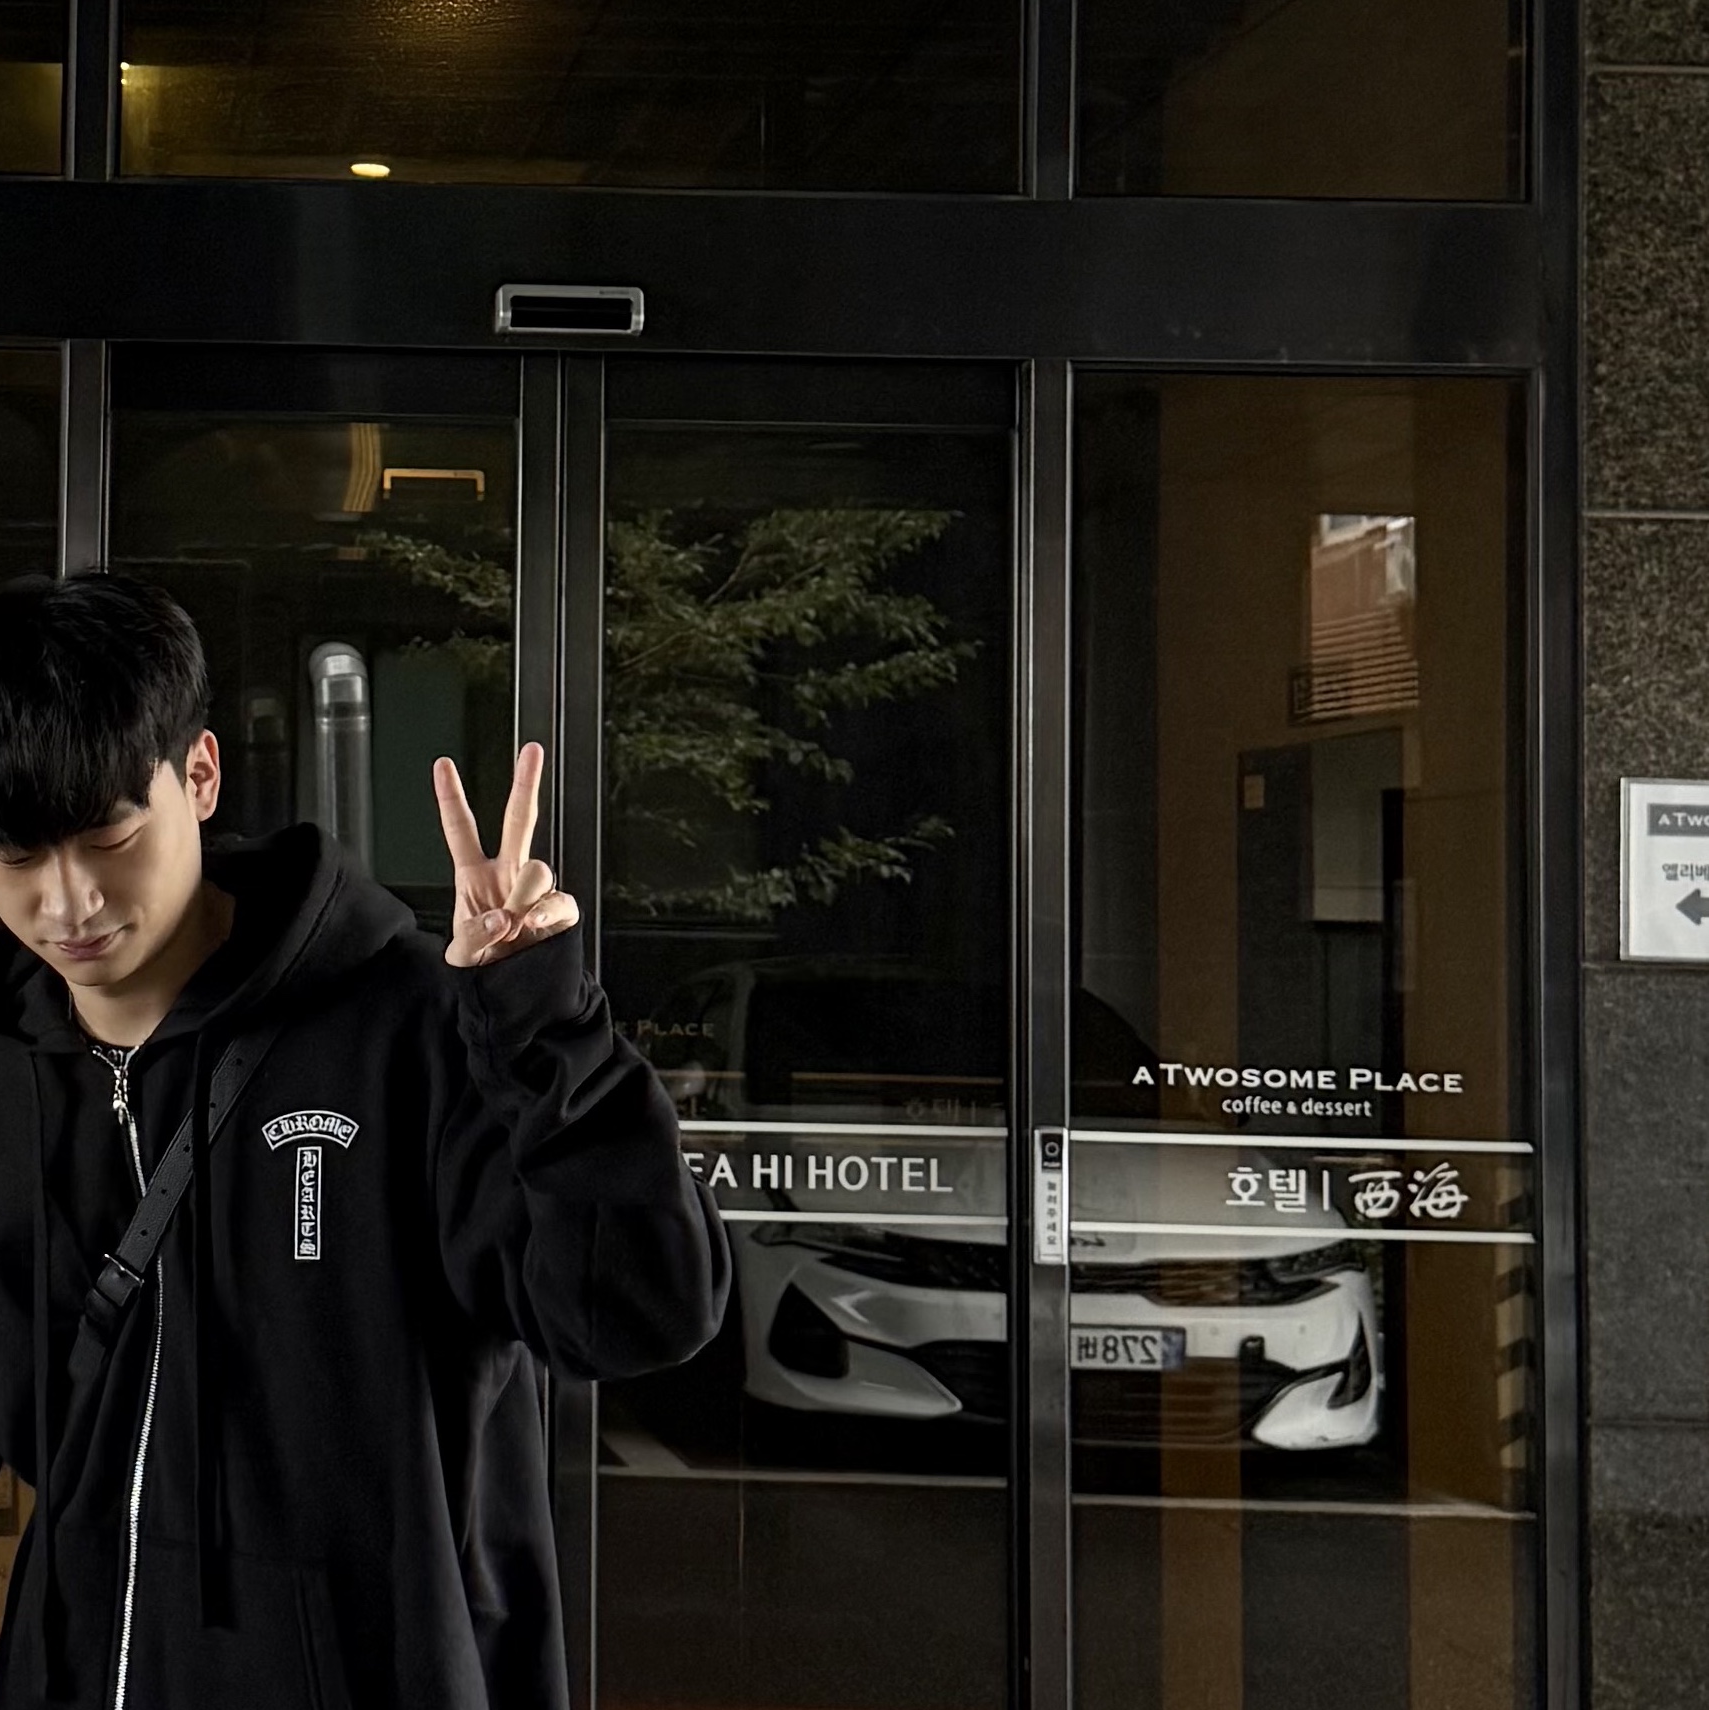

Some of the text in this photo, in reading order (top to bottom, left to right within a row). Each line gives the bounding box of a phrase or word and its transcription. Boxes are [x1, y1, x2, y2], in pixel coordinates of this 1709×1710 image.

[1132, 1063, 1464, 1094] A TWOSOME PLACE
[1222, 1096, 1373, 1118] coffee & dessert
[751, 1153, 793, 1191] HI
[807, 1154, 955, 1193] HOTEL
[1225, 1165, 1307, 1214] 호텔
